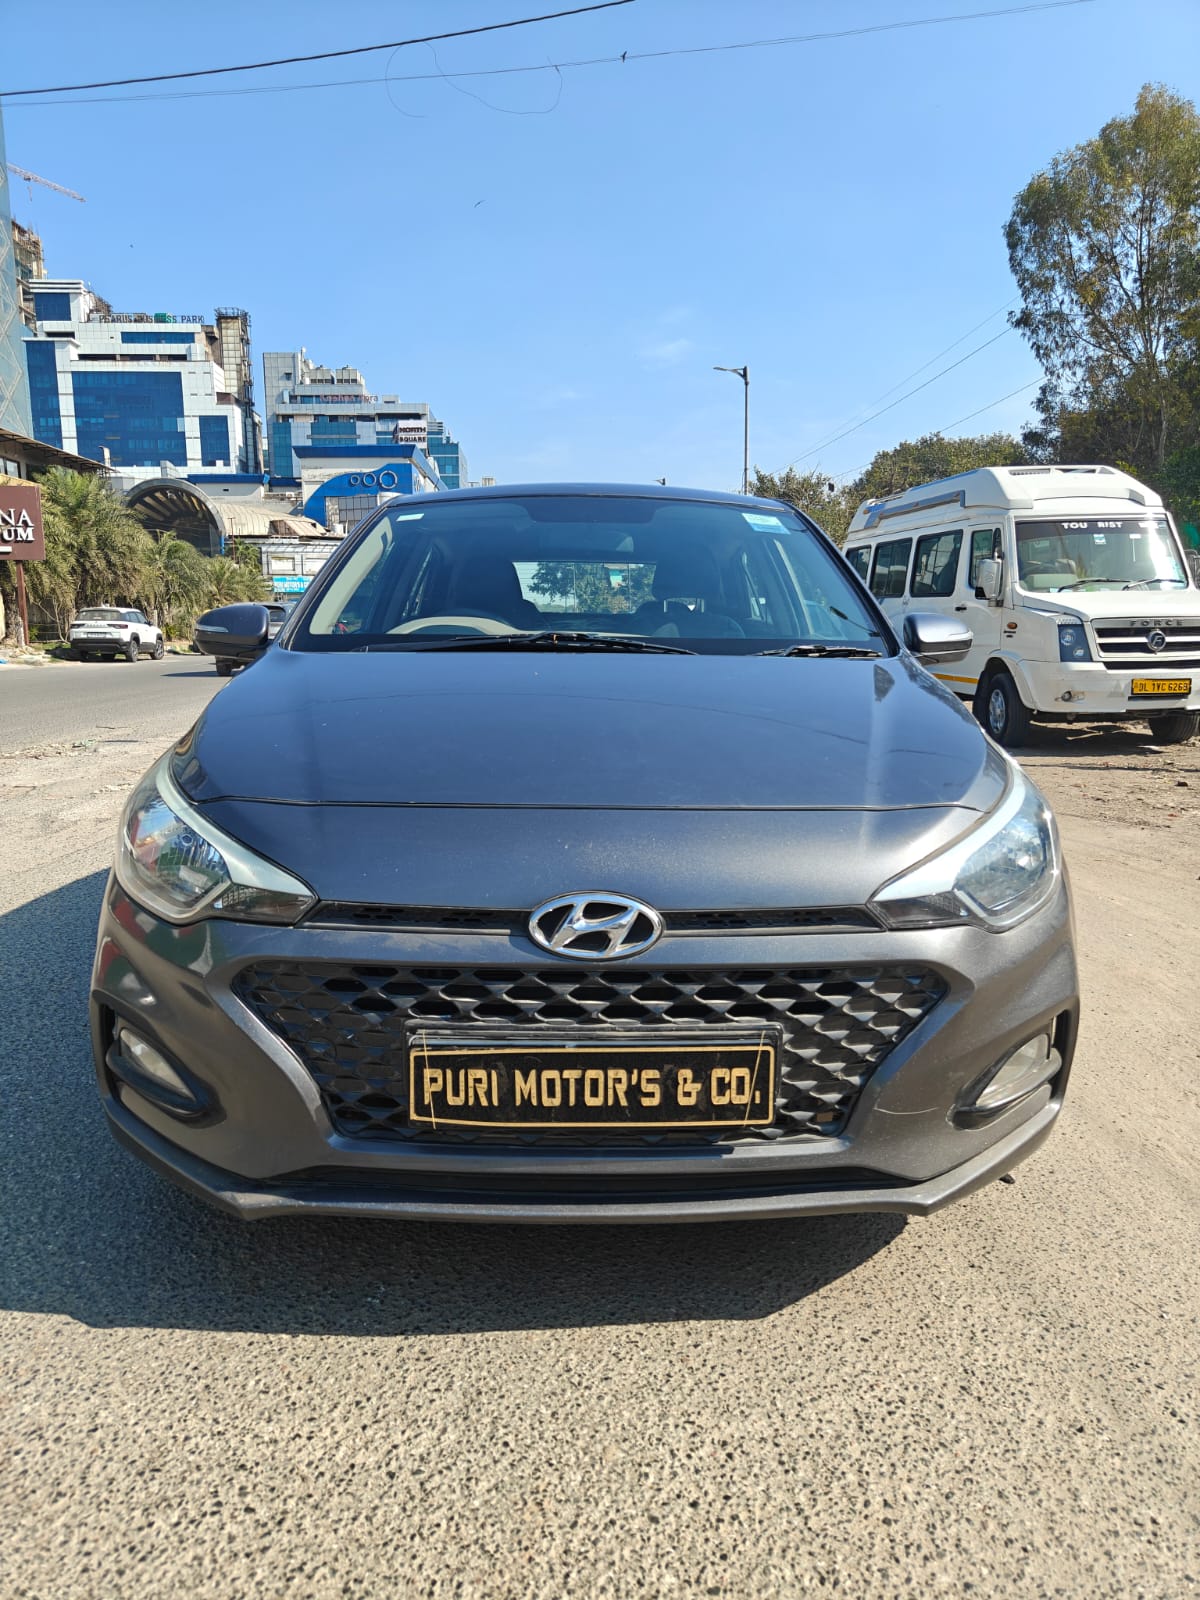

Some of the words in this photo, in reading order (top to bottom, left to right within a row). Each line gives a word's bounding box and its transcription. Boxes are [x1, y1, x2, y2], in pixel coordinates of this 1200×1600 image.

[181, 315, 204, 324] PARK
[1129, 619, 1185, 627] FORCE
[423, 1068, 499, 1107] PURI
[514, 1068, 661, 1107] MOTOR'S
[677, 1068, 702, 1107] &
[711, 1067, 761, 1106] CO.
